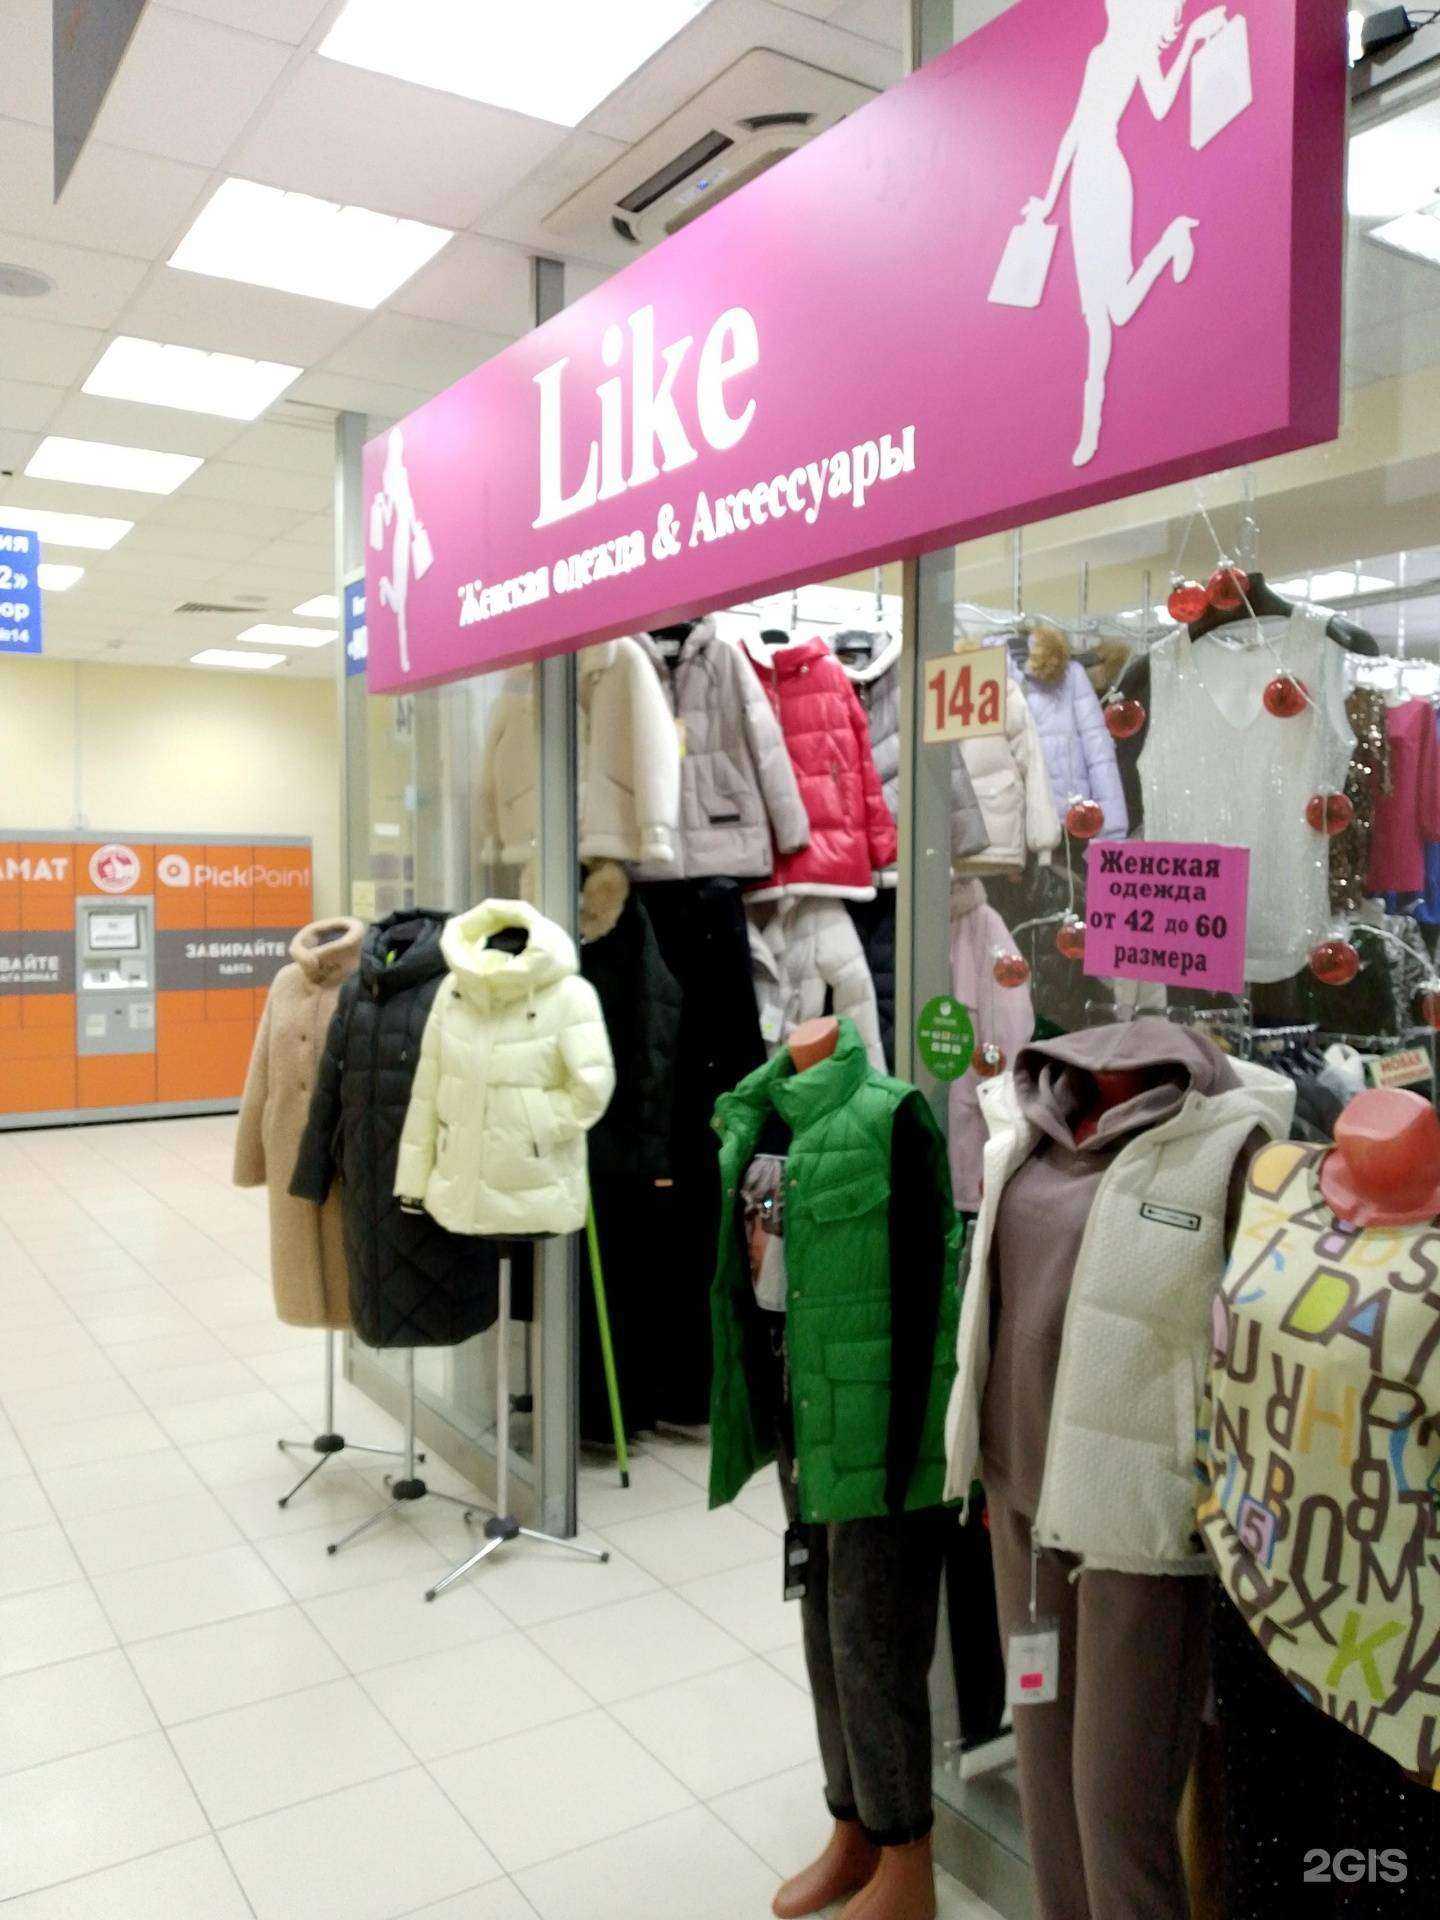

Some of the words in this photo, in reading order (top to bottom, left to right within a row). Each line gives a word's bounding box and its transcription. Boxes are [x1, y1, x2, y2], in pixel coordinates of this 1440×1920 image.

[532, 304, 760, 528] Like
[457, 566, 550, 627] Женская
[553, 529, 646, 591] одежда
[652, 503, 682, 561] &
[688, 425, 916, 547] Аксессуары
[928, 664, 1000, 731] 14а
[0, 857, 69, 882] МАТ
[193, 863, 312, 889] PickPoint
[1100, 849, 1221, 878] Женская
[1109, 881, 1207, 902] одежда
[1090, 911, 1116, 930] от
[1124, 909, 1155, 933] 42
[1164, 918, 1189, 934] до
[1195, 914, 1228, 939] 60
[184, 938, 286, 960] ЗАБИРАЙТЕ
[1113, 944, 1208, 976] размера
